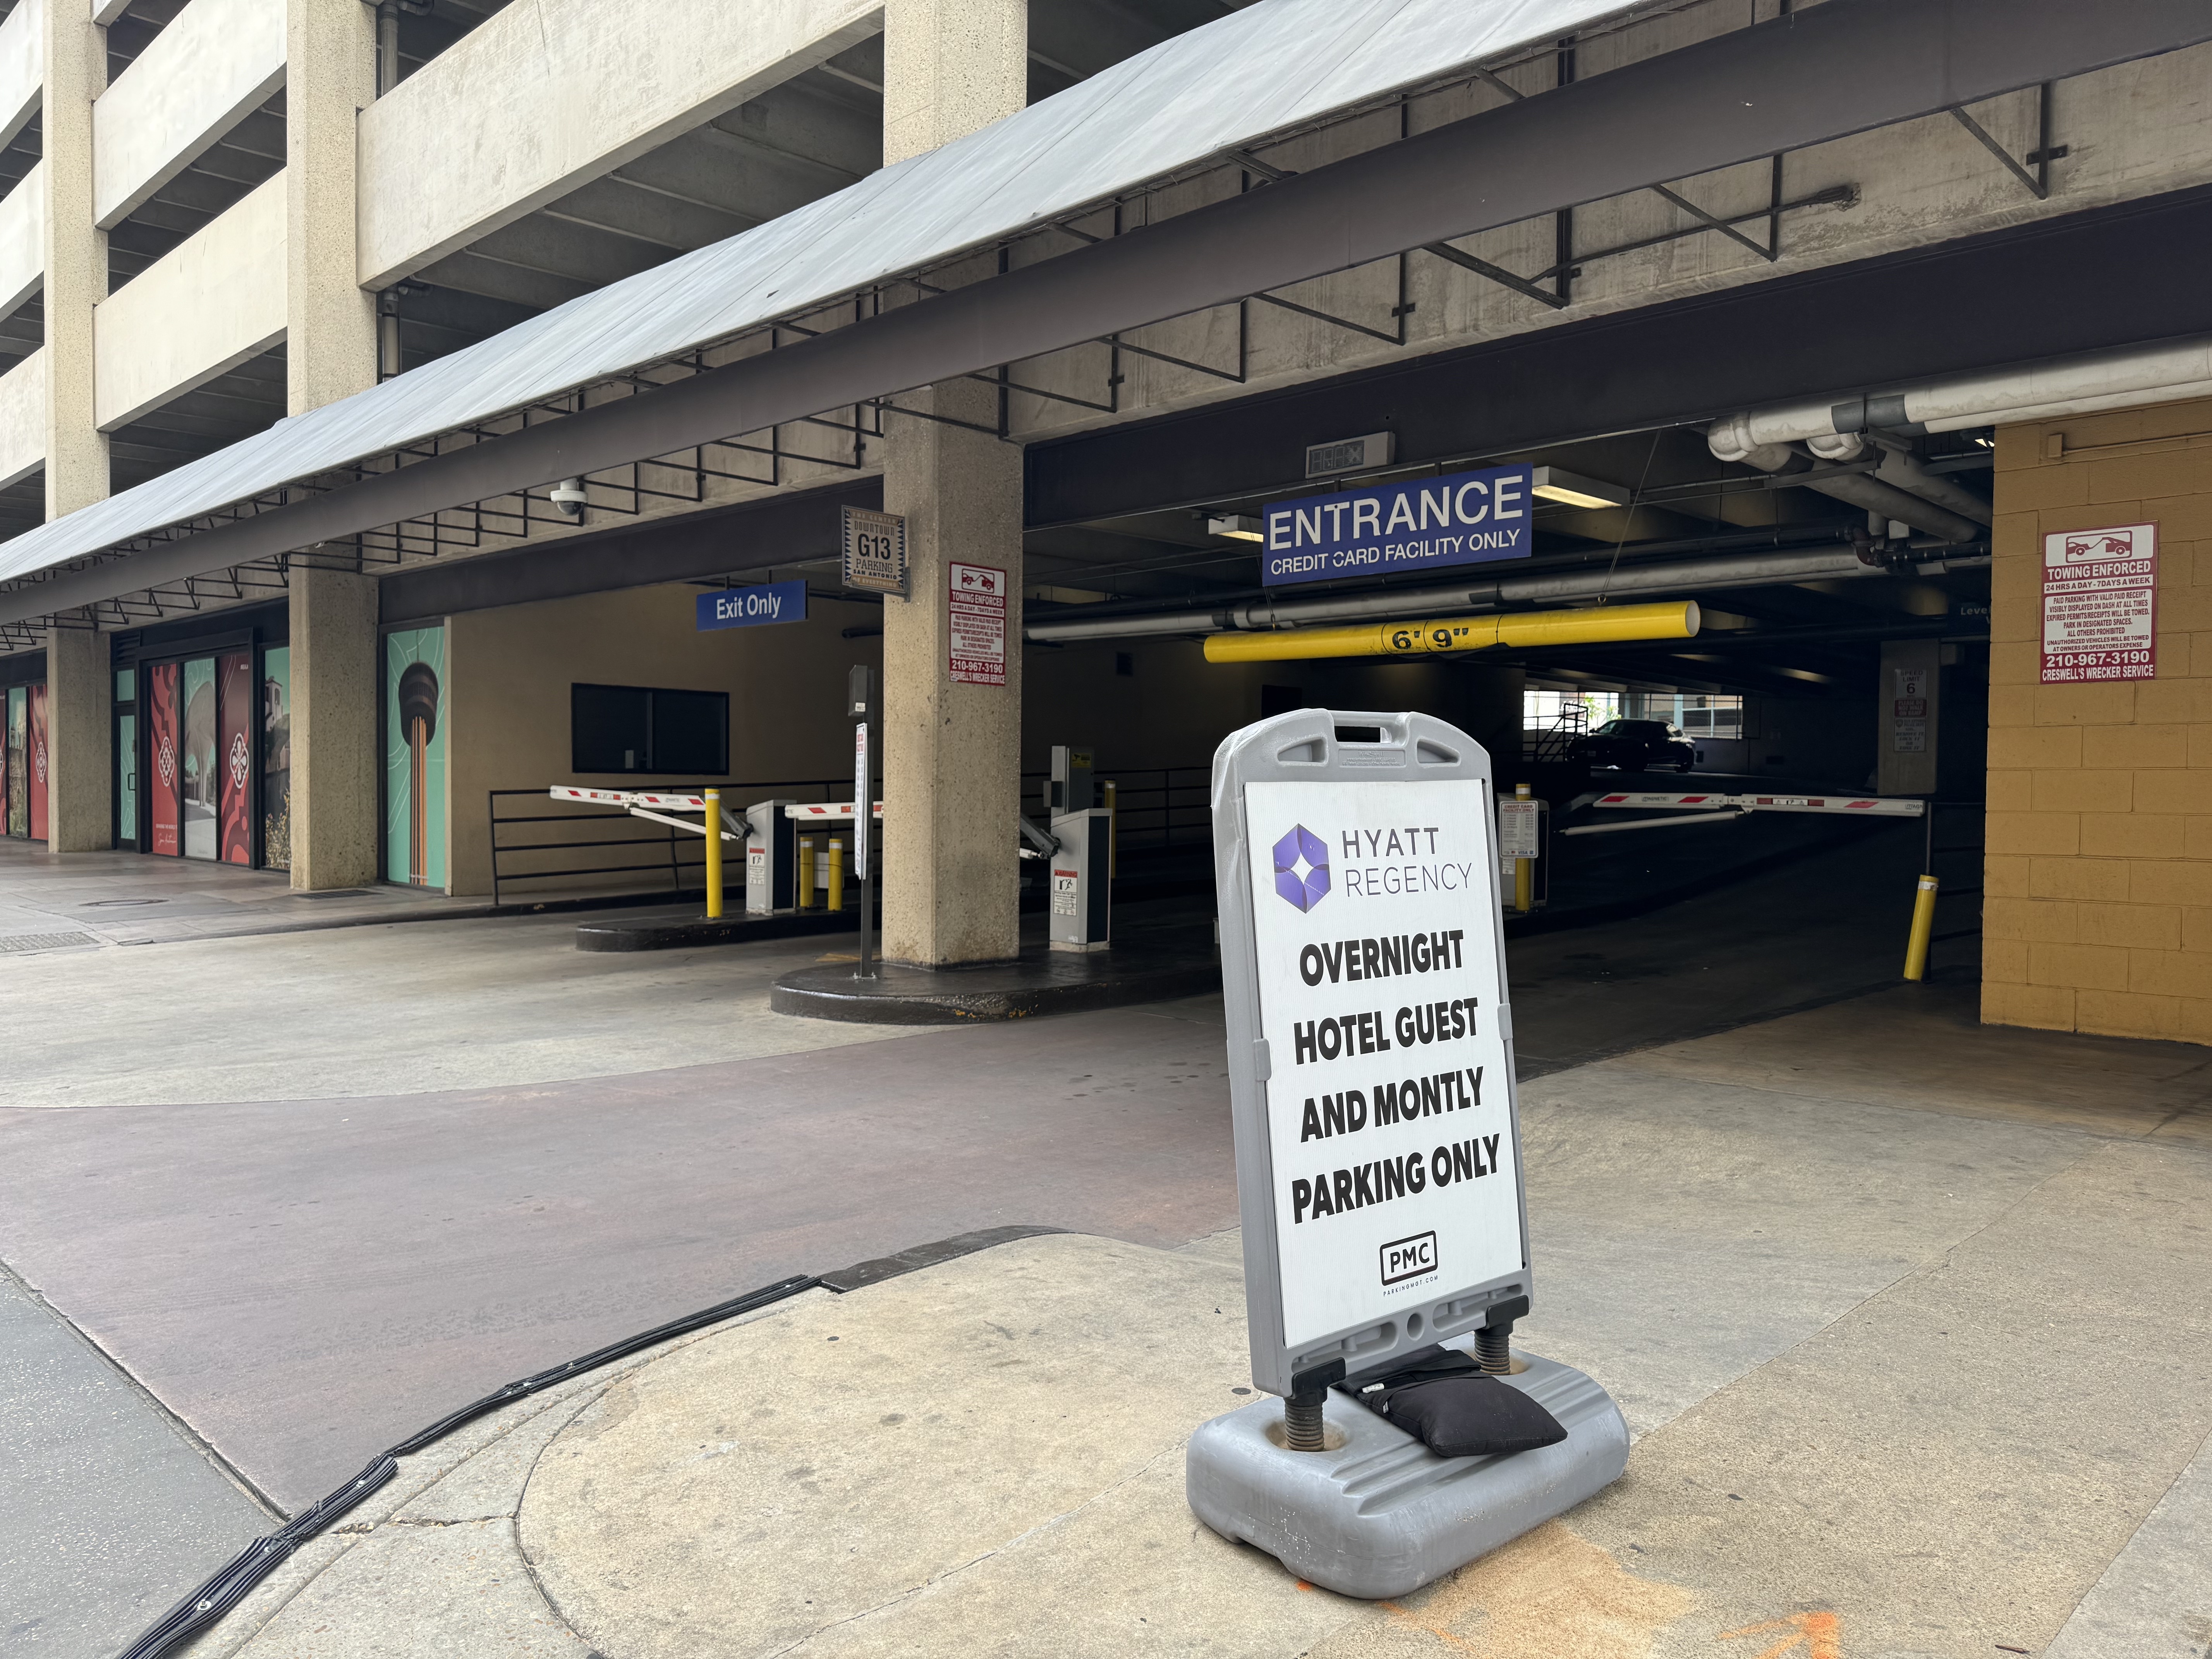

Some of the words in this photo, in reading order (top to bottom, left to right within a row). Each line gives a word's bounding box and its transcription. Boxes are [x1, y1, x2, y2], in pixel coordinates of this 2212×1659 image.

[1269, 475, 1523, 551] ENTRANCE
[858, 533, 891, 560] G13
[1271, 553, 1329, 575] CREDIT
[1333, 547, 1380, 567] CARD
[1385, 535, 1463, 561] FACILITY
[1468, 529, 1521, 551] ONLY
[856, 558, 892, 573] PARKING
[2048, 565, 2090, 580] TOWING
[2092, 560, 2151, 577] ENFORCED
[869, 571, 897, 579] ANTONIO
[2129, 577, 2150, 585] WEEK
[716, 597, 743, 620] Exit
[747, 592, 781, 618] Only
[952, 591, 974, 603] TOWING
[975, 594, 1004, 607] ENFORCED
[2065, 595, 2085, 604] PARKING
[2126, 591, 2147, 599] RECEIPT
[2068, 603, 2093, 611] DISPLAYED
[2083, 620, 2112, 628] DESIGNATED
[2096, 627, 2125, 635] PROHIBITED
[952, 660, 1003, 674] 210-967-3190
[2046, 651, 2149, 667] 210-967-3190
[990, 674, 1005, 684] SERVICE
[2042, 668, 2085, 681] CRESWELL'S
[2086, 666, 2121, 679] WRECKER
[2123, 664, 2154, 678] SERVICE
[1906, 683, 1915, 694] 6
[1342, 827, 1439, 859] HYATT
[1345, 862, 1472, 897] REGENCY
[1300, 929, 1463, 986] OVERNIGHT
[1294, 1010, 1390, 1065] HOTEL
[1395, 997, 1478, 1048] GUEST
[1301, 1090, 1367, 1143] AND
[1374, 1066, 1484, 1127] MONTLY
[1292, 1152, 1426, 1224] PARKING
[1431, 1133, 1500, 1188] ONLY
[1390, 1243, 1429, 1273] PMC
[1383, 1275, 1438, 1297] PARKINGMGT.COM
